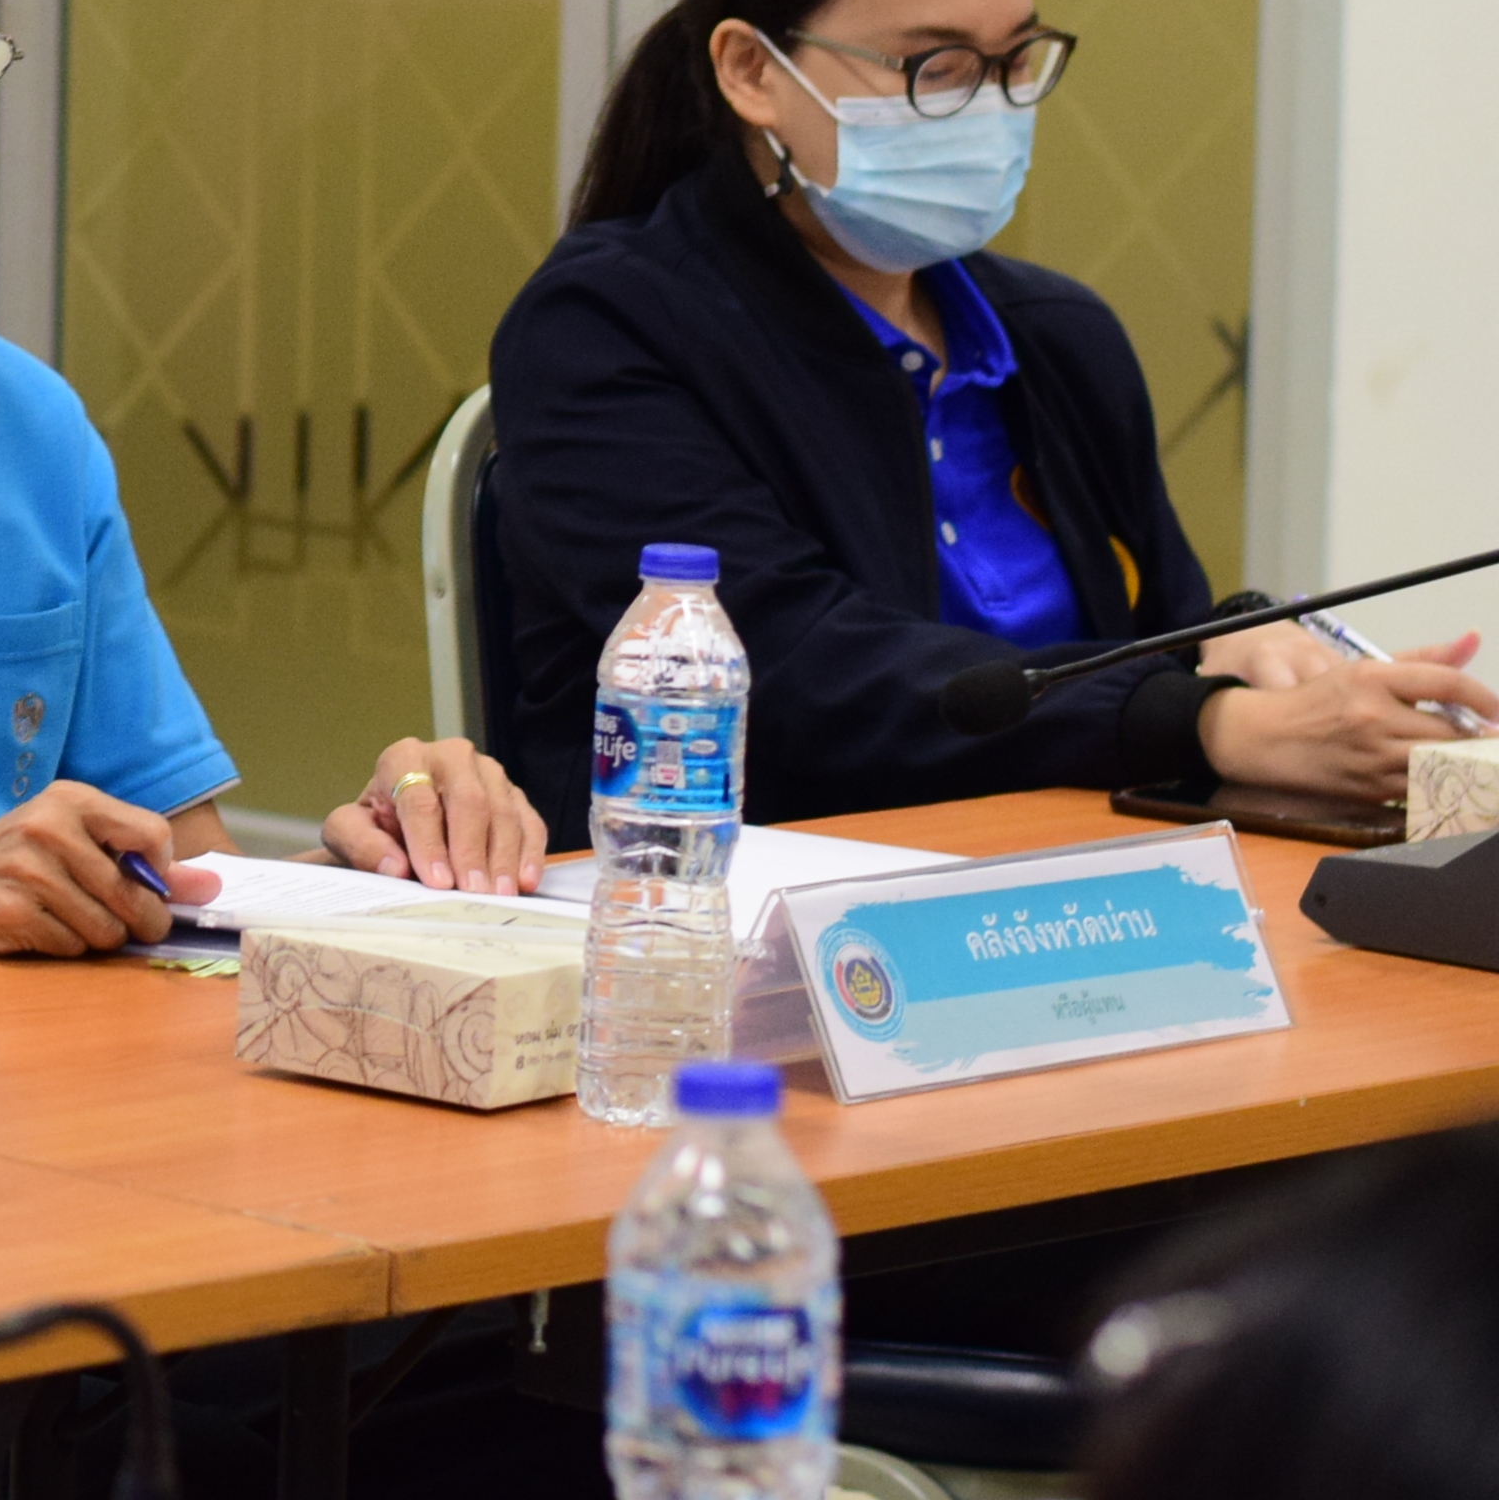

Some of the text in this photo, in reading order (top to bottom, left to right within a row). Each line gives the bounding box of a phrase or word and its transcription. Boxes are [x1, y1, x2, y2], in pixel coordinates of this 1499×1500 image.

[966, 899, 1158, 961] คลังจังหวัดน่าน
[1052, 989, 1126, 1025] หรือผู้แทน
